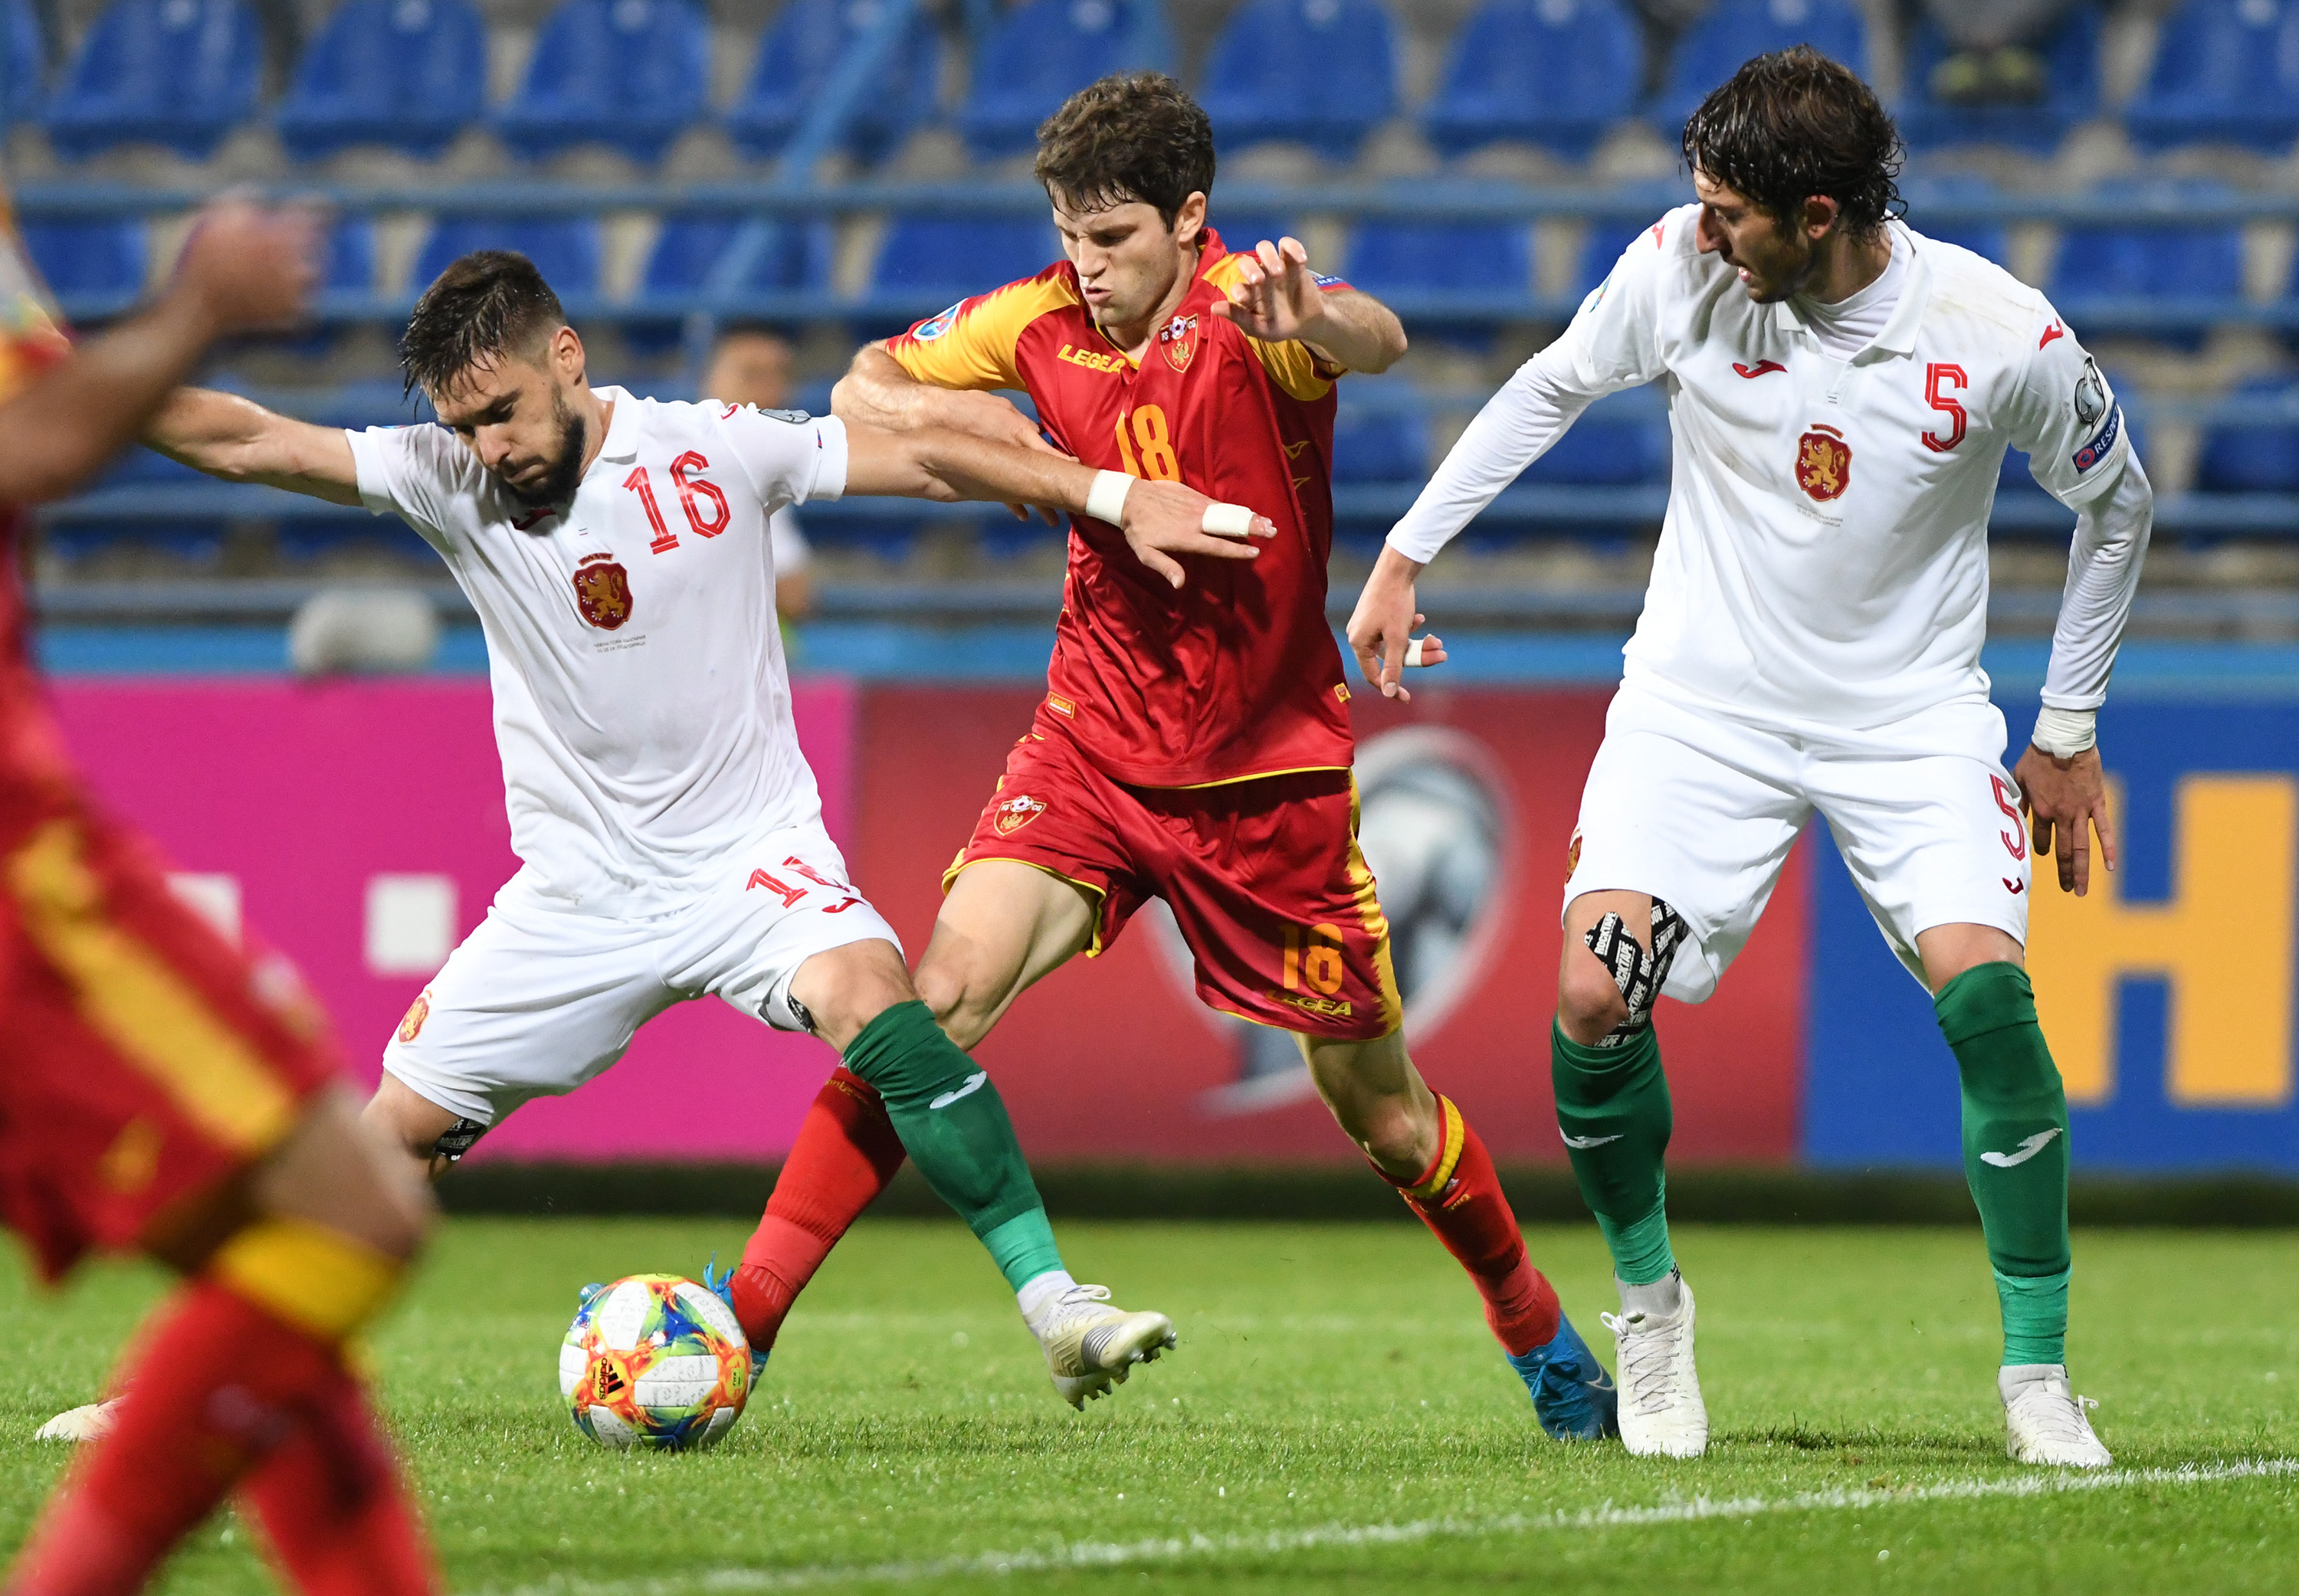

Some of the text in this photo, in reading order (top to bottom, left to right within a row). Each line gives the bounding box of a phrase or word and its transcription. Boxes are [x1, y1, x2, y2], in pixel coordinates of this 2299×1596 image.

[1057, 343, 1127, 375] LEGEA
[1115, 404, 1181, 483] 18
[1921, 362, 1967, 453] 5
[621, 450, 731, 555] 16
[1989, 772, 2027, 862] 5
[1277, 922, 1343, 995] 18
[1615, 941, 1634, 991] OCKTAPE
[1265, 989, 1352, 1016] LEGEA
[599, 1358, 609, 1400] adidas
